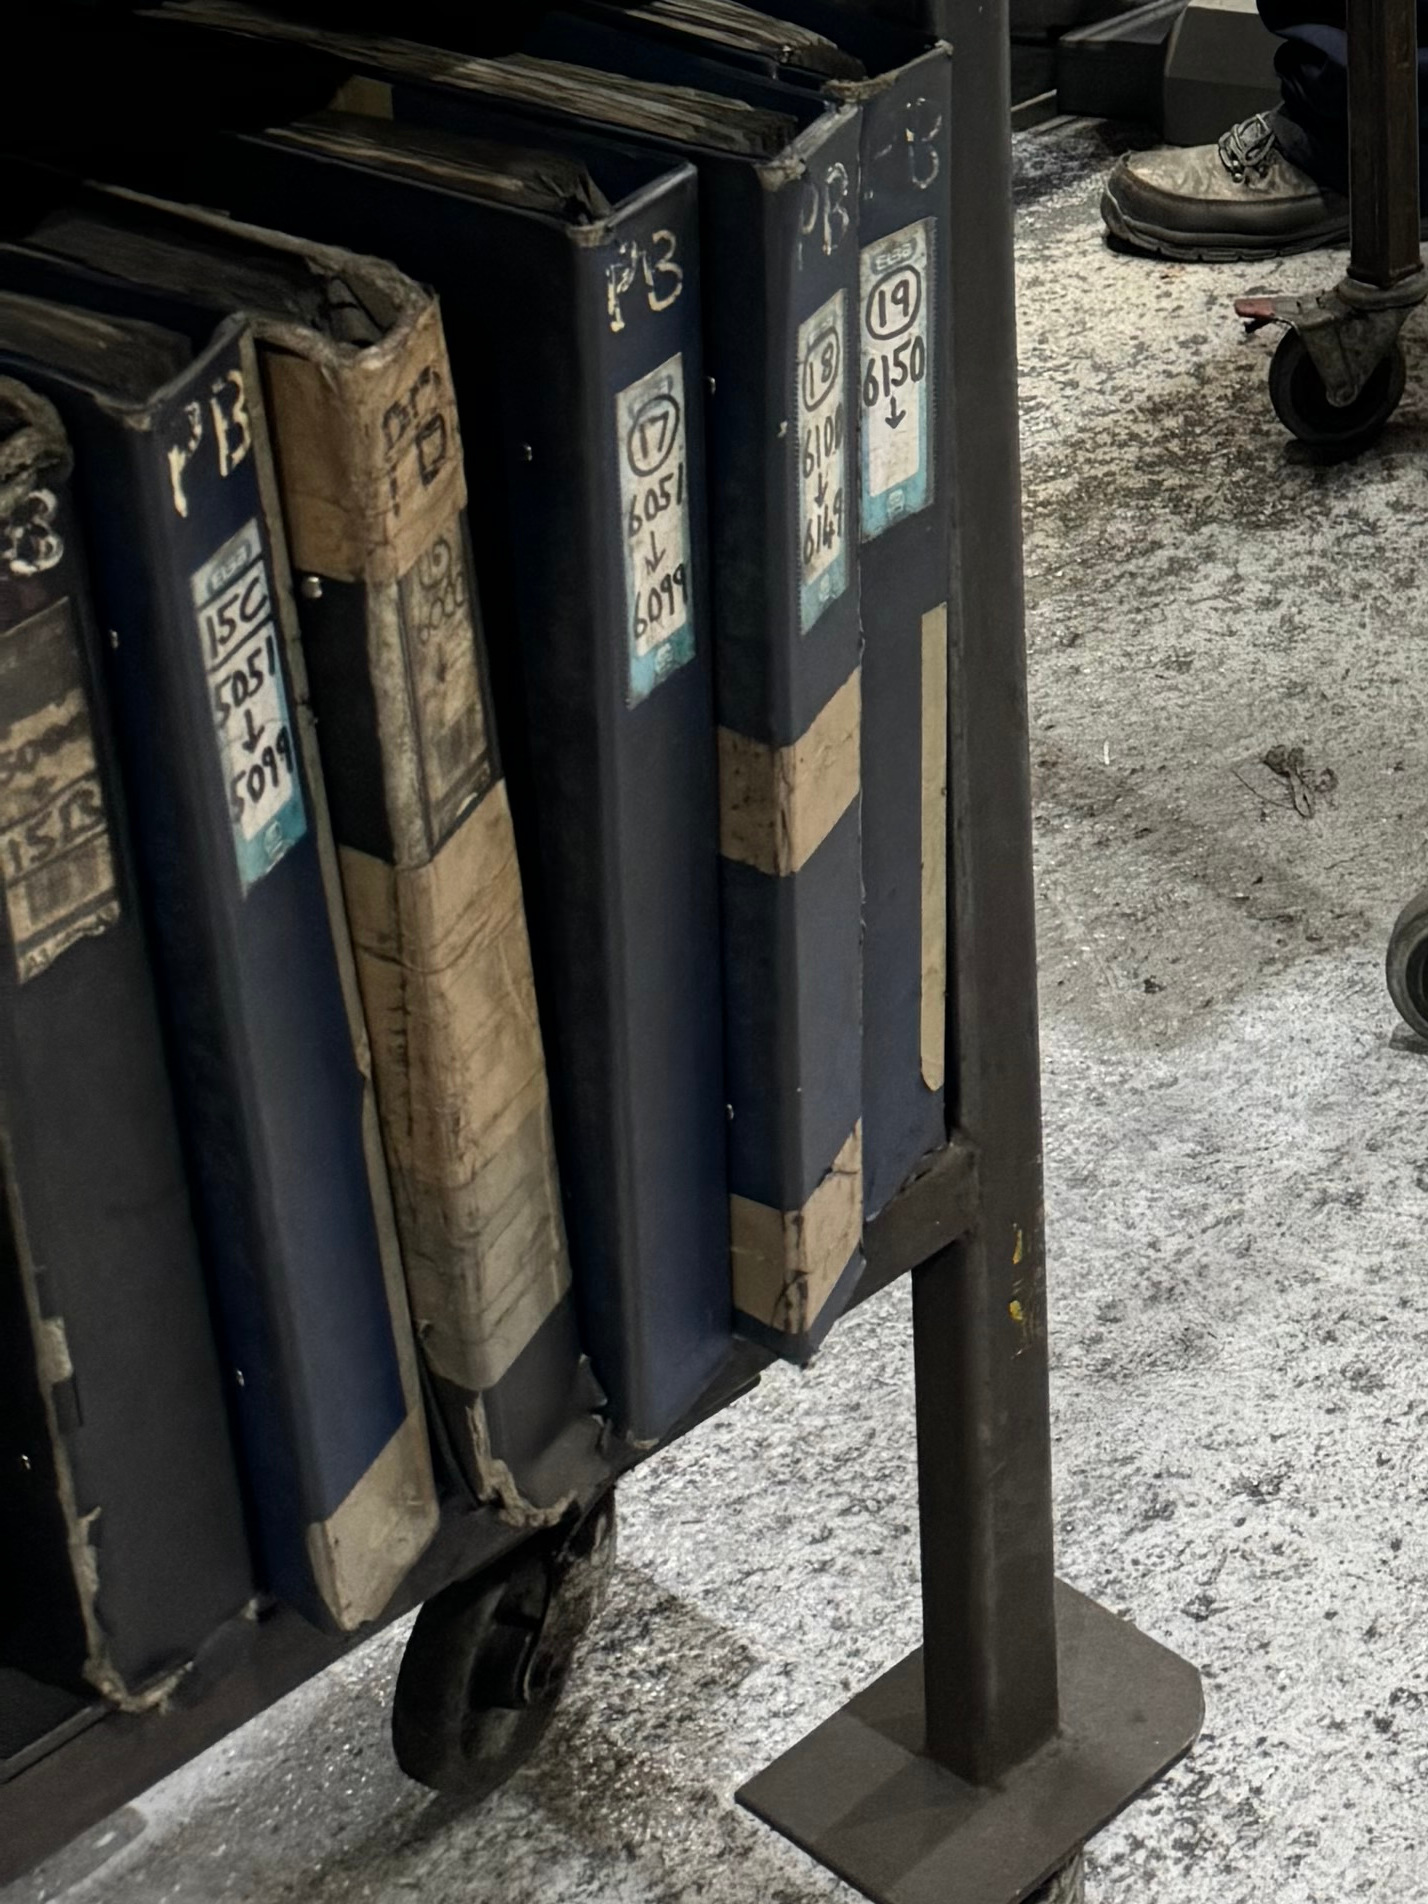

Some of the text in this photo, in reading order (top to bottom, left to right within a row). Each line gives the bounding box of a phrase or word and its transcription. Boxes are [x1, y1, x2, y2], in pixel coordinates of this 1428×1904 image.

[879, 279, 910, 329] 19
[808, 341, 835, 400] 18
[863, 336, 927, 407] 6150
[640, 409, 671, 460] 17
[802, 402, 843, 479] 6100
[628, 462, 684, 538] 6051
[802, 487, 844, 565] 6149
[205, 576, 268, 660] 15C
[634, 564, 688, 639] 6099
[212, 634, 276, 730] 5051
[231, 725, 293, 824] 5099
